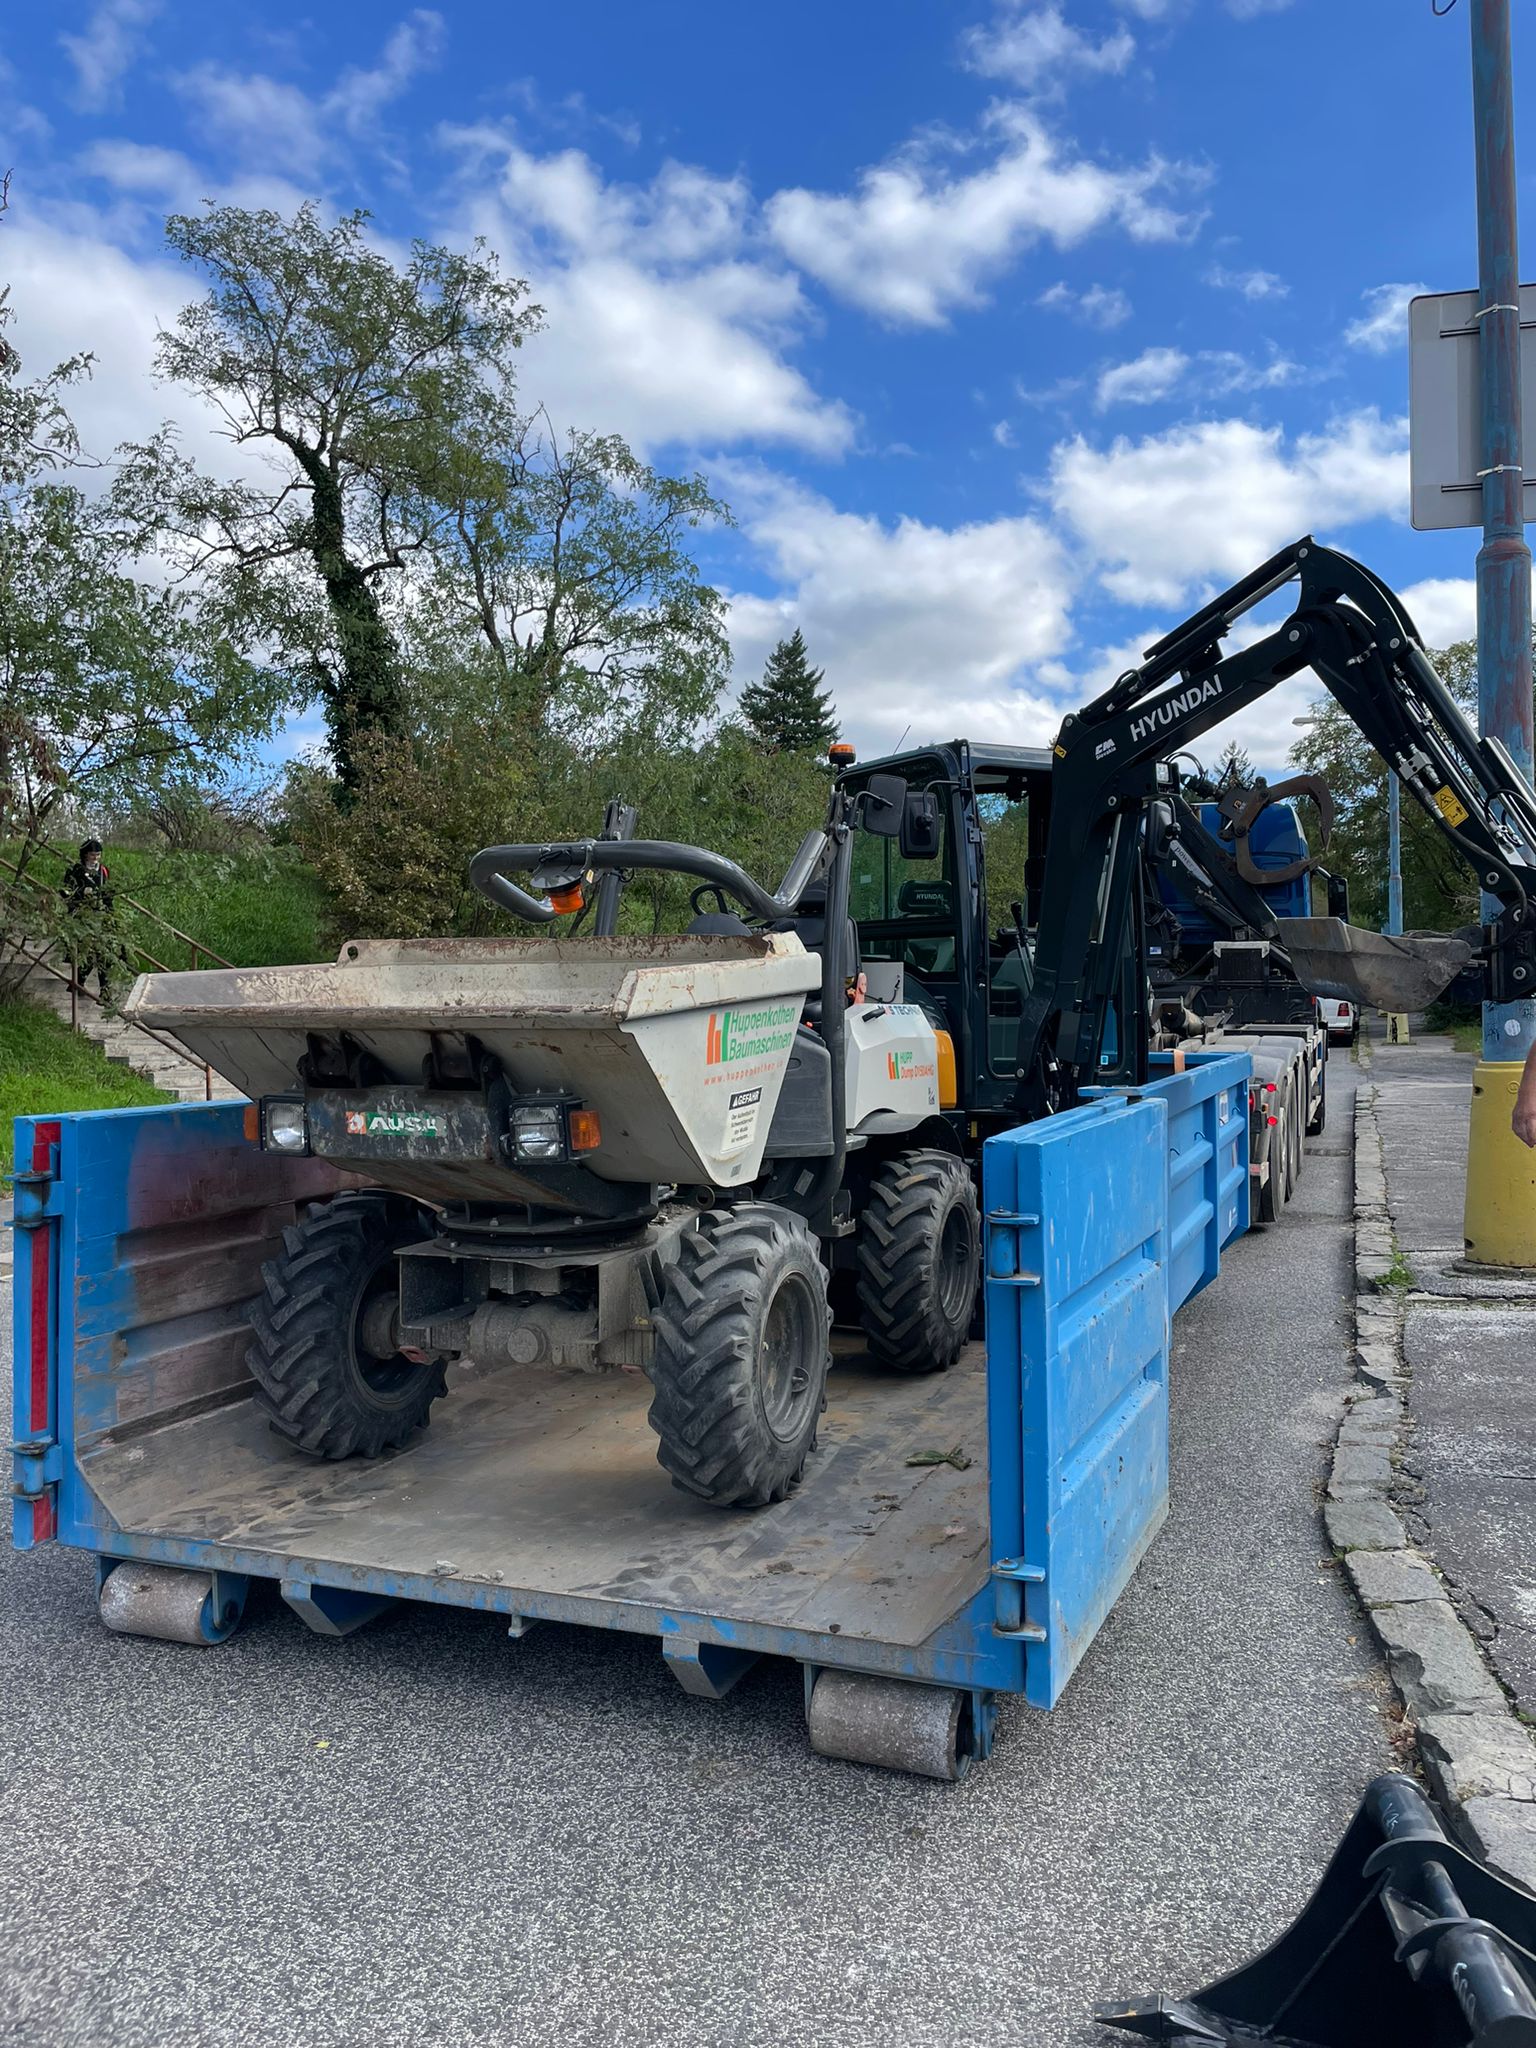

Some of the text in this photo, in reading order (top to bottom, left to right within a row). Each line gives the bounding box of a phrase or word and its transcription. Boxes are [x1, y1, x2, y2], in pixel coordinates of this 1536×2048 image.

[1129, 673, 1223, 742] HYUNDAI
[730, 1004, 796, 1037] Huppenkothen
[728, 1030, 793, 1062] Baumaschinen
[737, 1090, 760, 1106] GEFAHR
